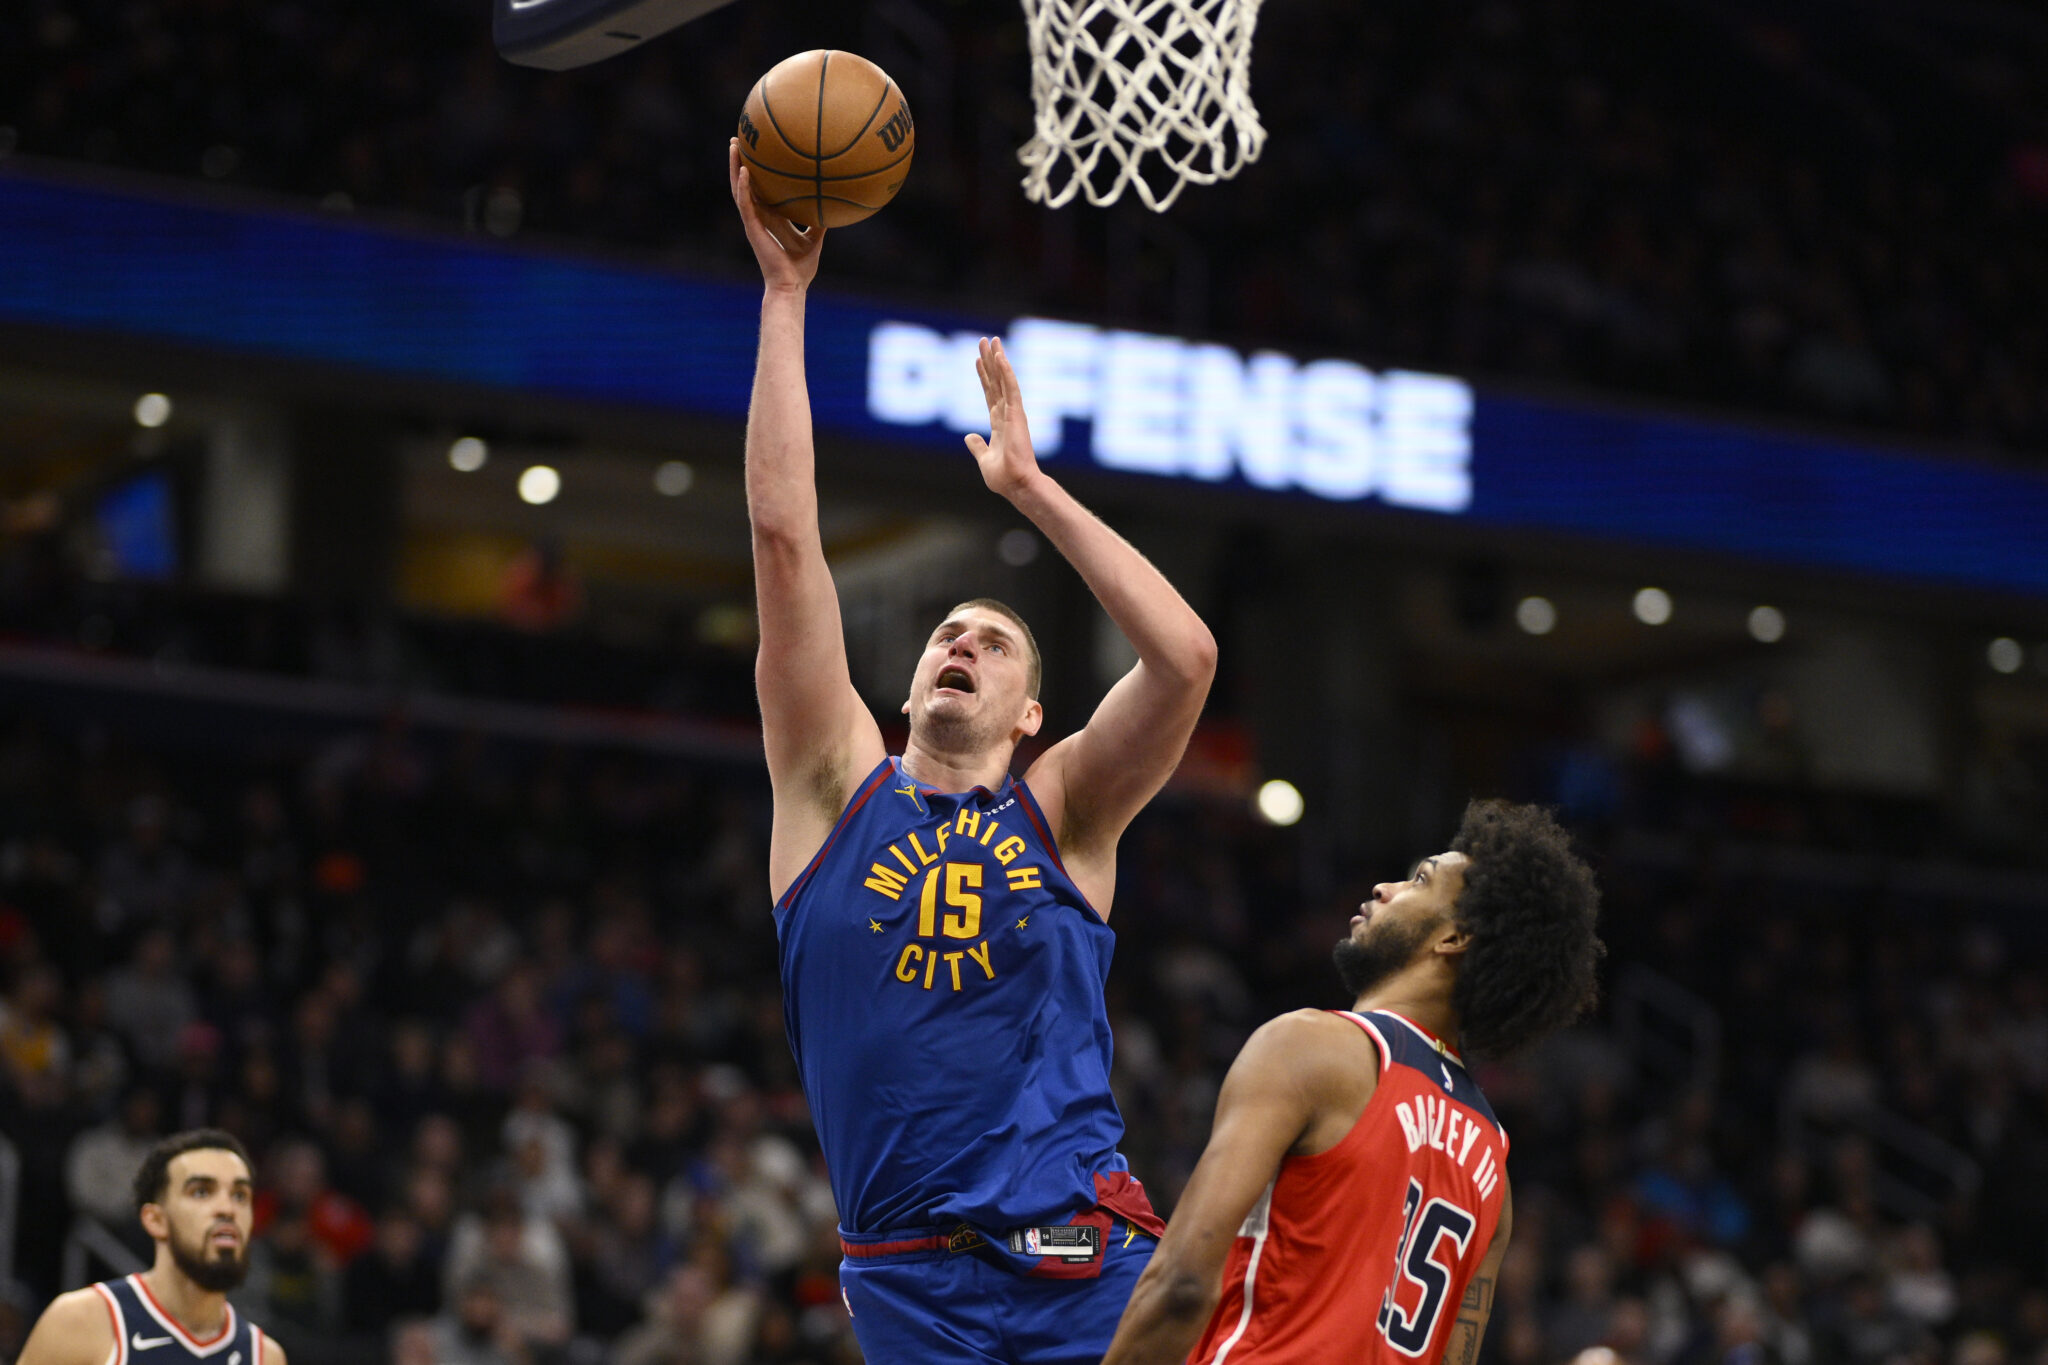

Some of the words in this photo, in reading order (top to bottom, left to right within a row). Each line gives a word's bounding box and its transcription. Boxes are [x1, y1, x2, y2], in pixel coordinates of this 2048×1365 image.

[866, 316, 1474, 514] DEFENSE
[955, 808, 1043, 892] HIGH
[918, 862, 984, 939] 15
[895, 940, 996, 991] CITY
[1395, 1094, 1482, 1168] BAGLEY
[1472, 1145, 1499, 1202] III
